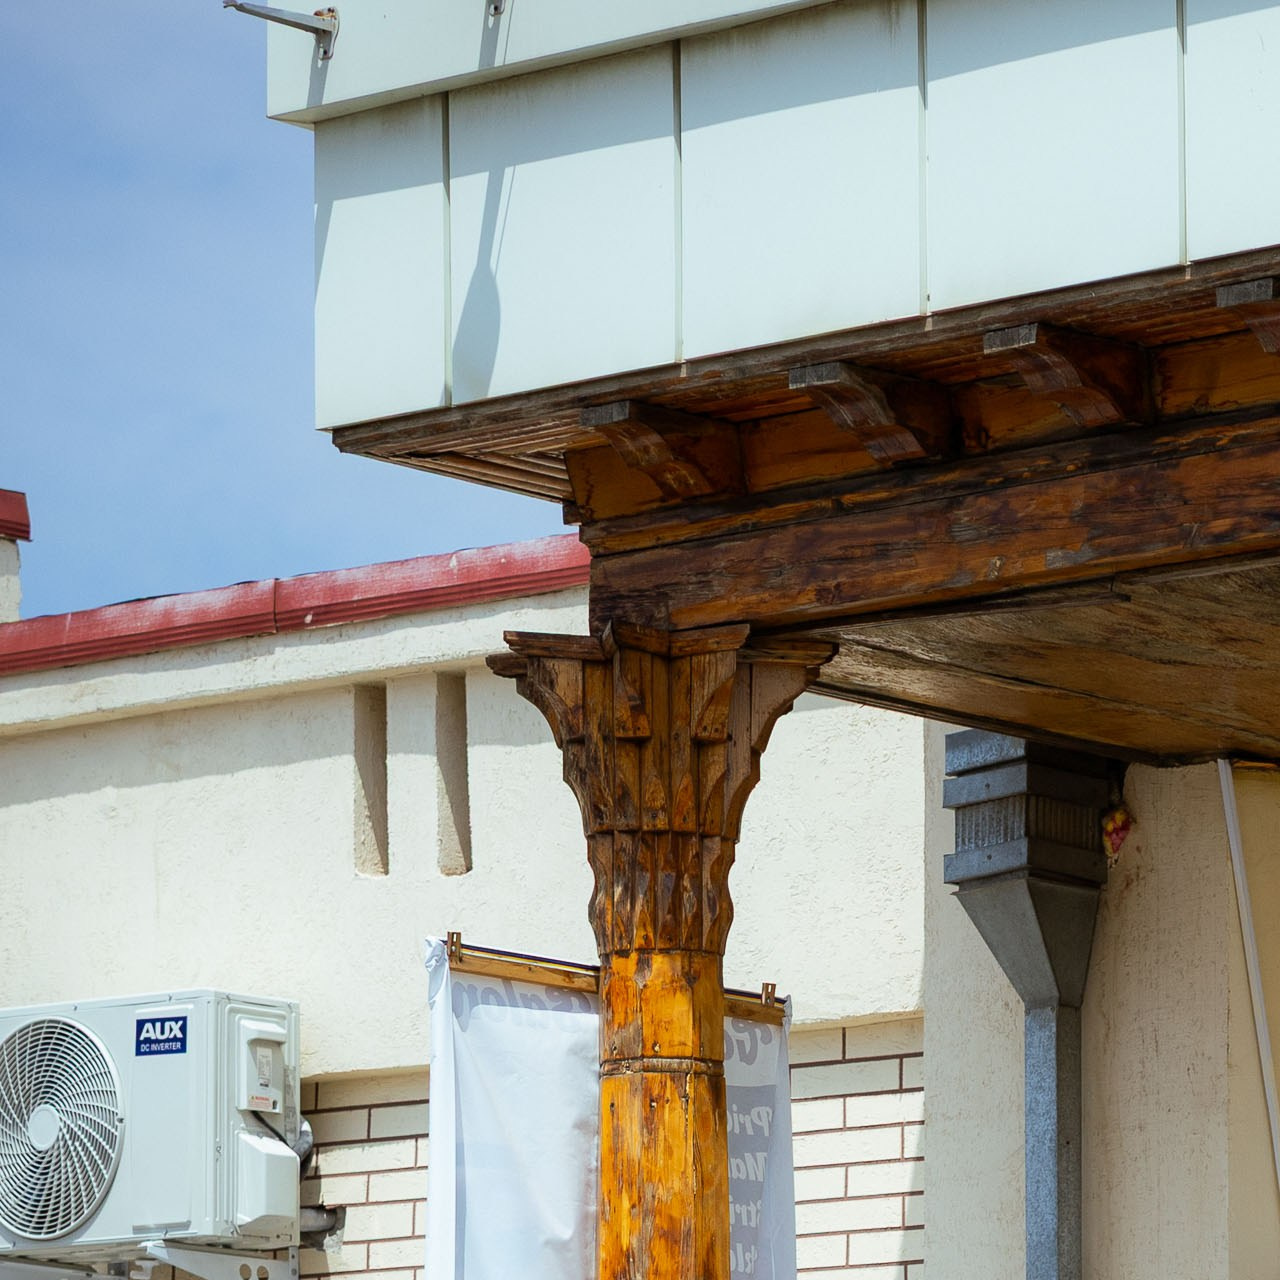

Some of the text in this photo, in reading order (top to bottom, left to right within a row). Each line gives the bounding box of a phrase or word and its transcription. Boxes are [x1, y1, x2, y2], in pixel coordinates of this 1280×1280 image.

[139, 1020, 184, 1041] AUX
[140, 1042, 182, 1052] DC INVERTER
